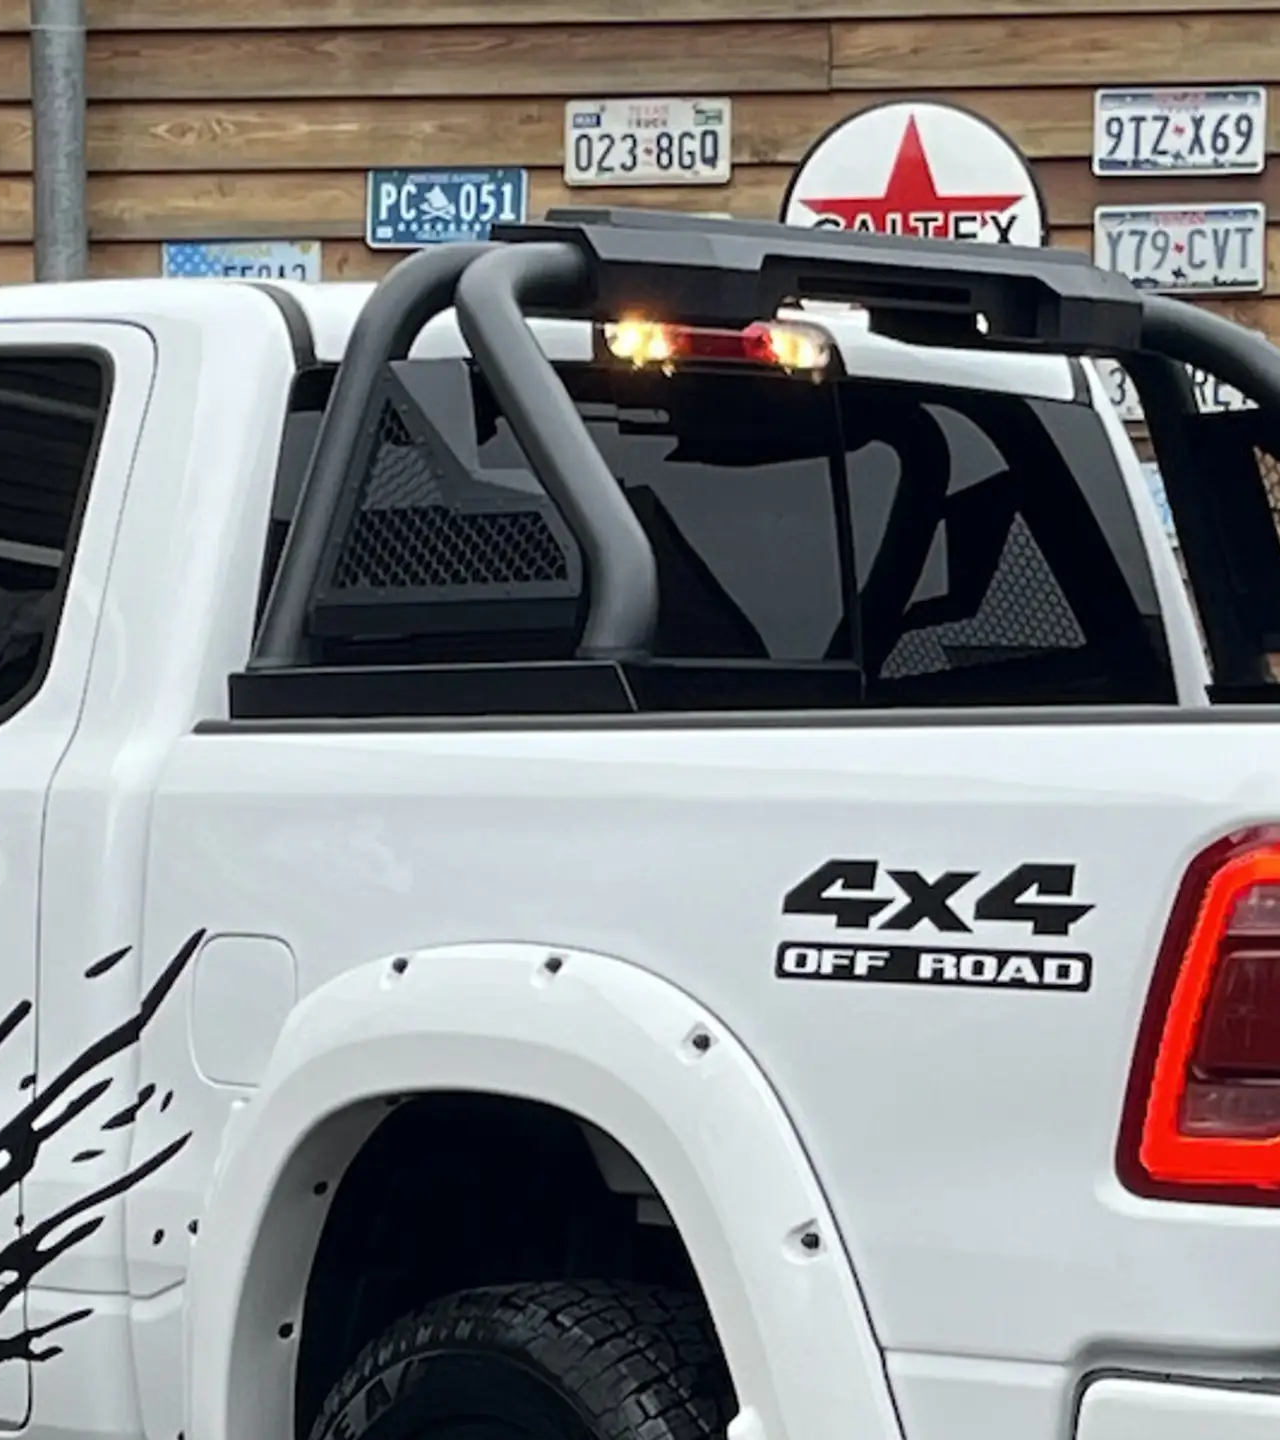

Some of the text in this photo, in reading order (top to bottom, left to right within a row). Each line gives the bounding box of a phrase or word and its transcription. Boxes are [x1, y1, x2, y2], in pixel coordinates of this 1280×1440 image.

[575, 130, 720, 172] 023 8GQ
[1105, 113, 1254, 158] 9TZ X69
[379, 182, 517, 221] PC 051
[1107, 226, 1254, 274] Y79 CVT
[783, 947, 1084, 985] OFF ROAD
